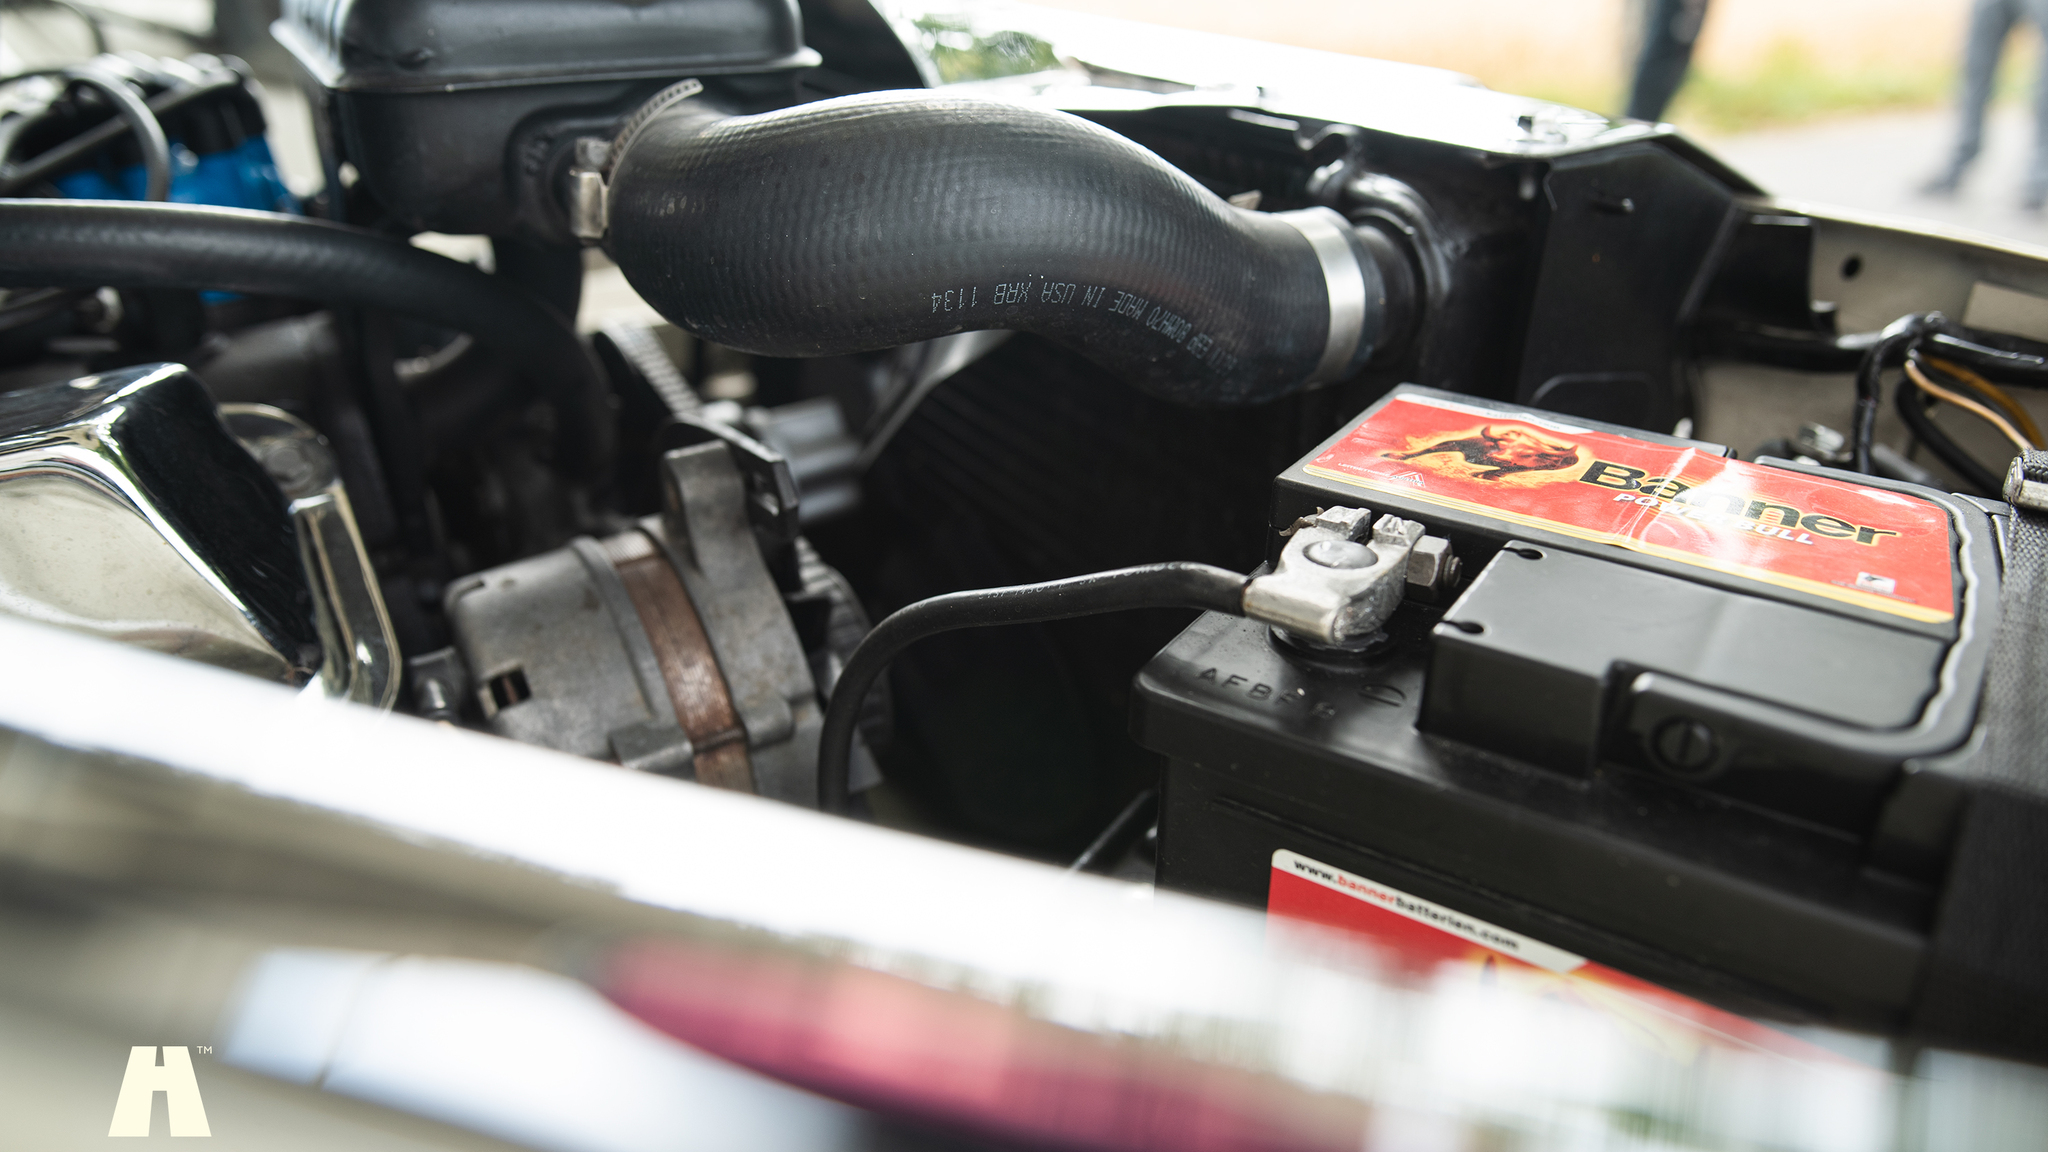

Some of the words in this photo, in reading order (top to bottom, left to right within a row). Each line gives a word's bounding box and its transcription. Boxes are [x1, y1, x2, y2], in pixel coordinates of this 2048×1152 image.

[931, 286, 978, 313] 1134
[1041, 282, 1075, 305] USA
[1082, 285, 1107, 308] IN
[1109, 291, 1147, 319] MADE
[1580, 461, 1897, 546] Banner
[1613, 493, 1729, 525] POWER
[1734, 519, 1814, 545] BULL
[1293, 859, 1519, 949] www.bannerbatterien.com
